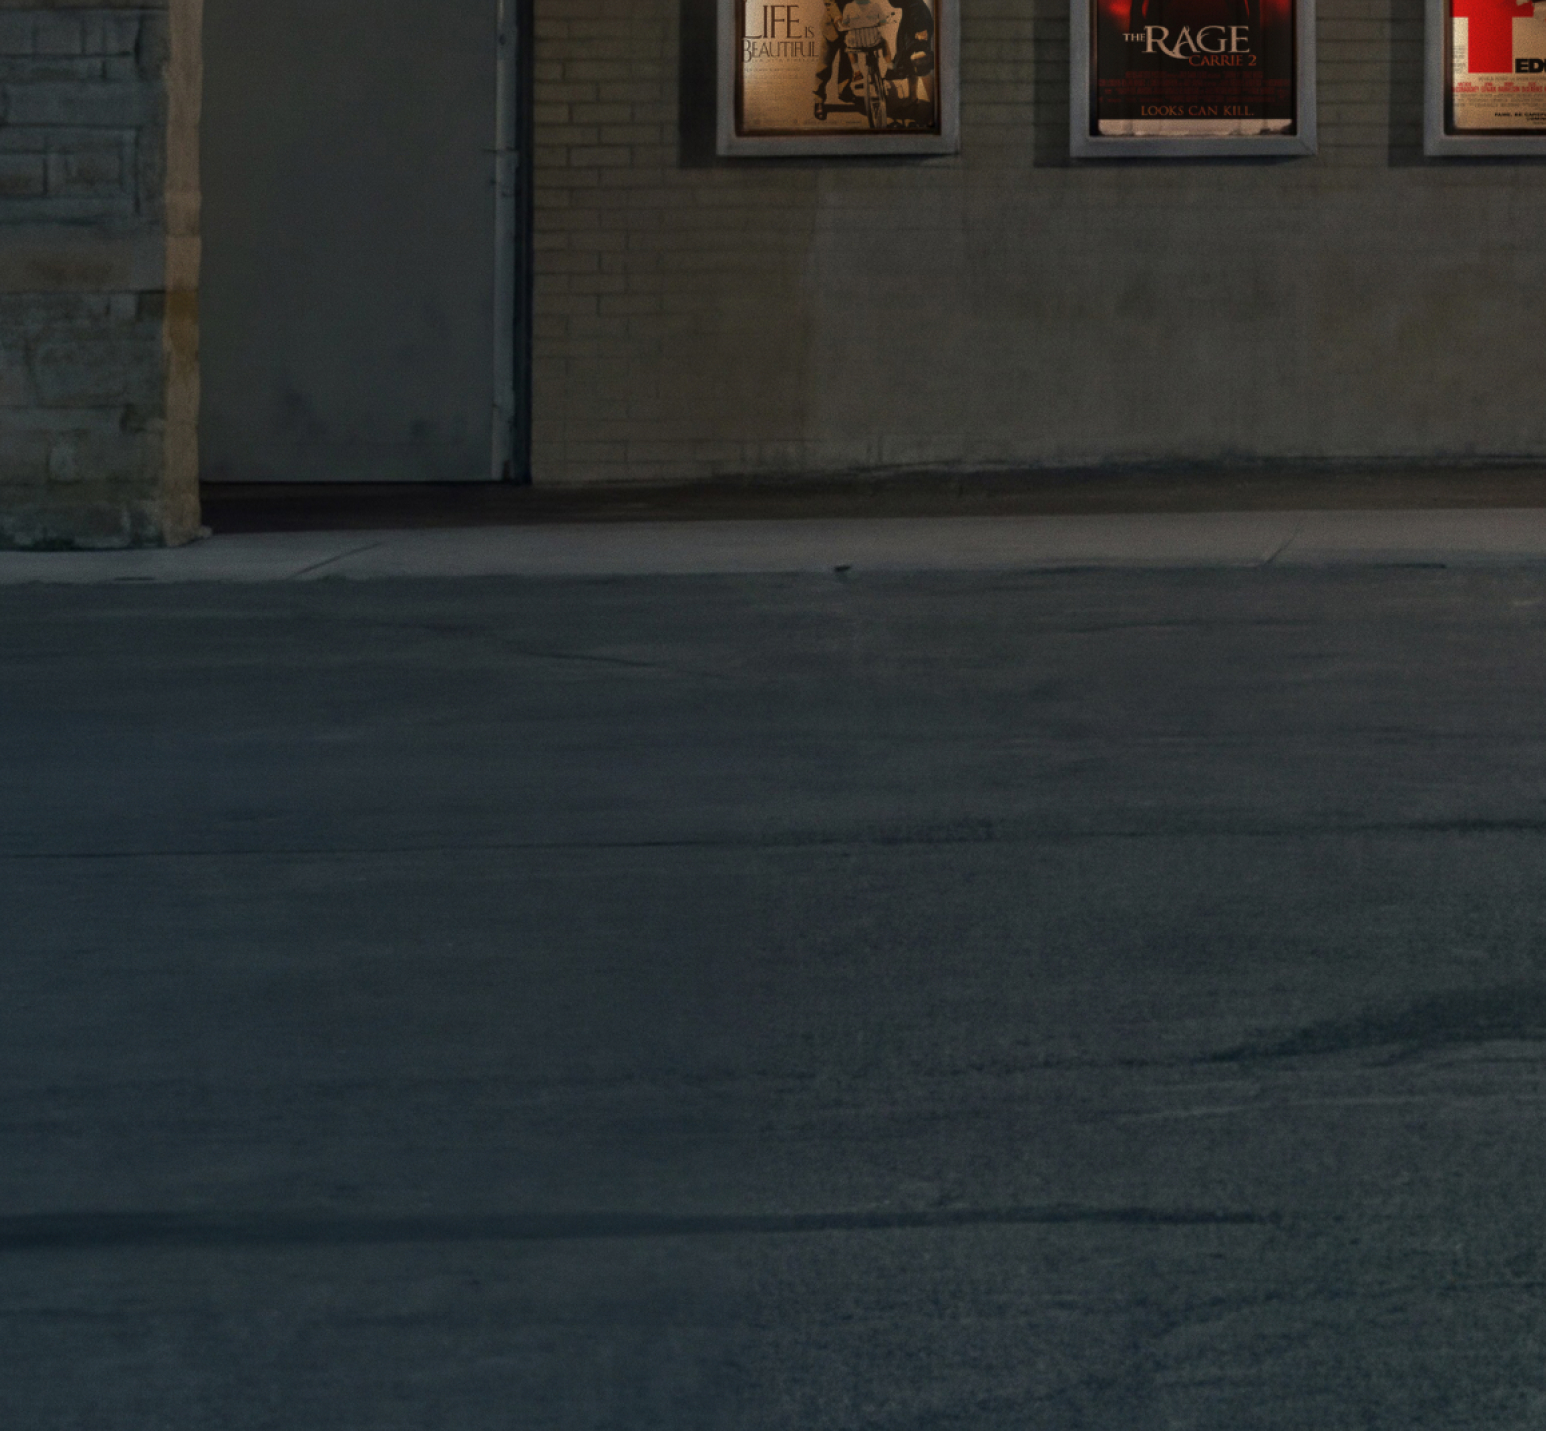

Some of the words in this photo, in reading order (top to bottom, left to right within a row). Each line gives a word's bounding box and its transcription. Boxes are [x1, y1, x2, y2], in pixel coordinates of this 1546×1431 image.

[741, 0, 803, 39] LIFE
[804, 26, 816, 39] IS
[743, 40, 820, 63] BEAUTIFUL
[1123, 32, 1146, 43] THE
[1142, 25, 1250, 59] RAGE
[1188, 54, 1244, 67] CARRIE
[1247, 54, 1258, 67] 2
[1141, 105, 1184, 117] LOOKS
[1188, 105, 1218, 117] CAN
[1223, 105, 1255, 117] KILL.
